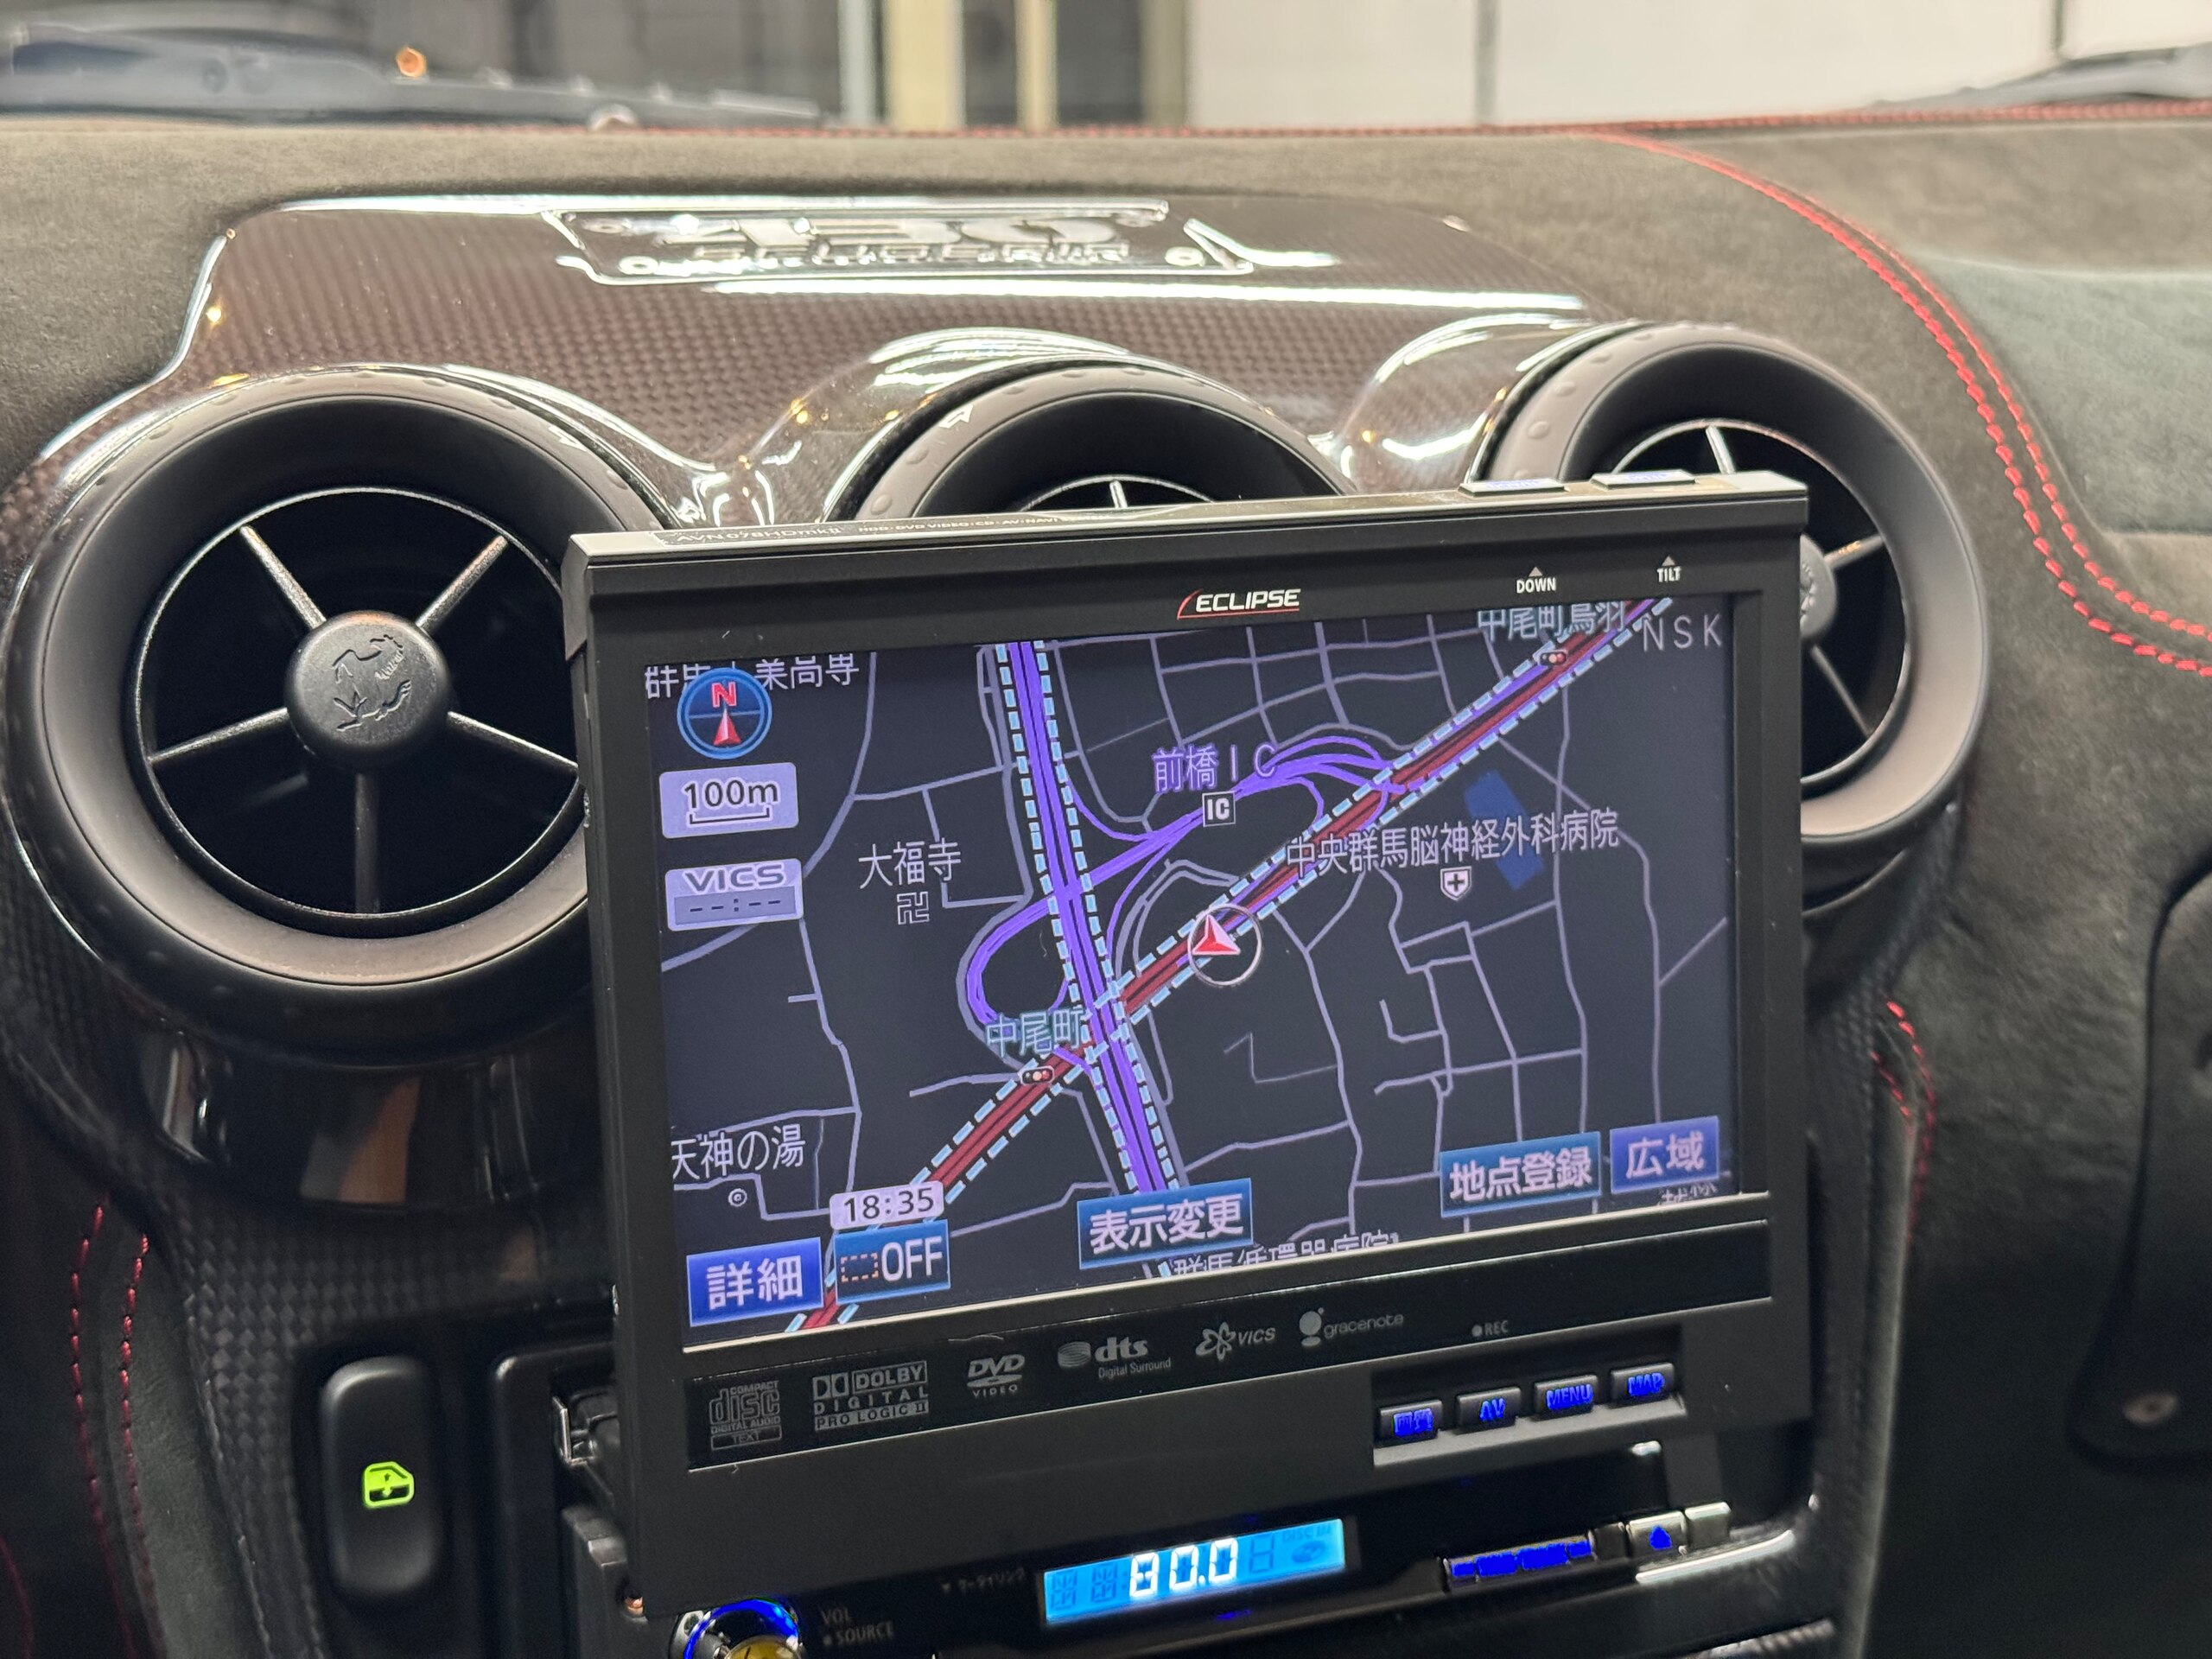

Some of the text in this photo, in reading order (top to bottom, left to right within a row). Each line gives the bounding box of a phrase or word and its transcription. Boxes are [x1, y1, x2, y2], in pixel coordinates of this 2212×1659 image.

[1516, 577, 1556, 594] DOWN
[1657, 566, 1681, 582] TILT
[1196, 588, 1301, 613] ECLIPSE
[711, 682, 737, 709] N
[683, 779, 779, 810] 100m
[1207, 798, 1230, 820] IC
[1286, 806, 1619, 878] 中央群馬脳神経外科病院
[859, 837, 961, 889] 大福寺
[684, 864, 786, 892] VICS
[986, 1011, 1084, 1058] 中尾町
[671, 1123, 806, 1179] 天神の湯
[1626, 1130, 1704, 1179] 広域
[1449, 1146, 1593, 1201] 地点登録
[843, 1186, 934, 1222] 18:35
[1090, 1193, 1244, 1254] 表示変更
[880, 1235, 944, 1282] OFF
[706, 1255, 804, 1311] 詳細
[1238, 1327, 1276, 1345] VICS
[1324, 1313, 1404, 1340] gracenote
[1484, 1320, 1509, 1337] REC
[1095, 1337, 1148, 1363] dts
[855, 1364, 923, 1390] DOLBY
[968, 1353, 1026, 1378] DVD
[1098, 1357, 1172, 1380] Digital Surround
[730, 1380, 779, 1395] COMPACT
[972, 1384, 1019, 1398] VIDEO
[1546, 1383, 1593, 1411] MENU
[1628, 1372, 1666, 1397] MAP
[709, 1388, 779, 1425] disc
[814, 1385, 929, 1416] DIGITAL
[1479, 1398, 1506, 1422] AV
[710, 1419, 749, 1435] DIGITAL
[817, 1414, 850, 1428] PRO
[857, 1405, 908, 1422] LOGIC
[732, 1431, 760, 1444] TEXT
[1129, 1537, 1239, 1599] 80.0
[836, 1620, 894, 1643] SOURCE
